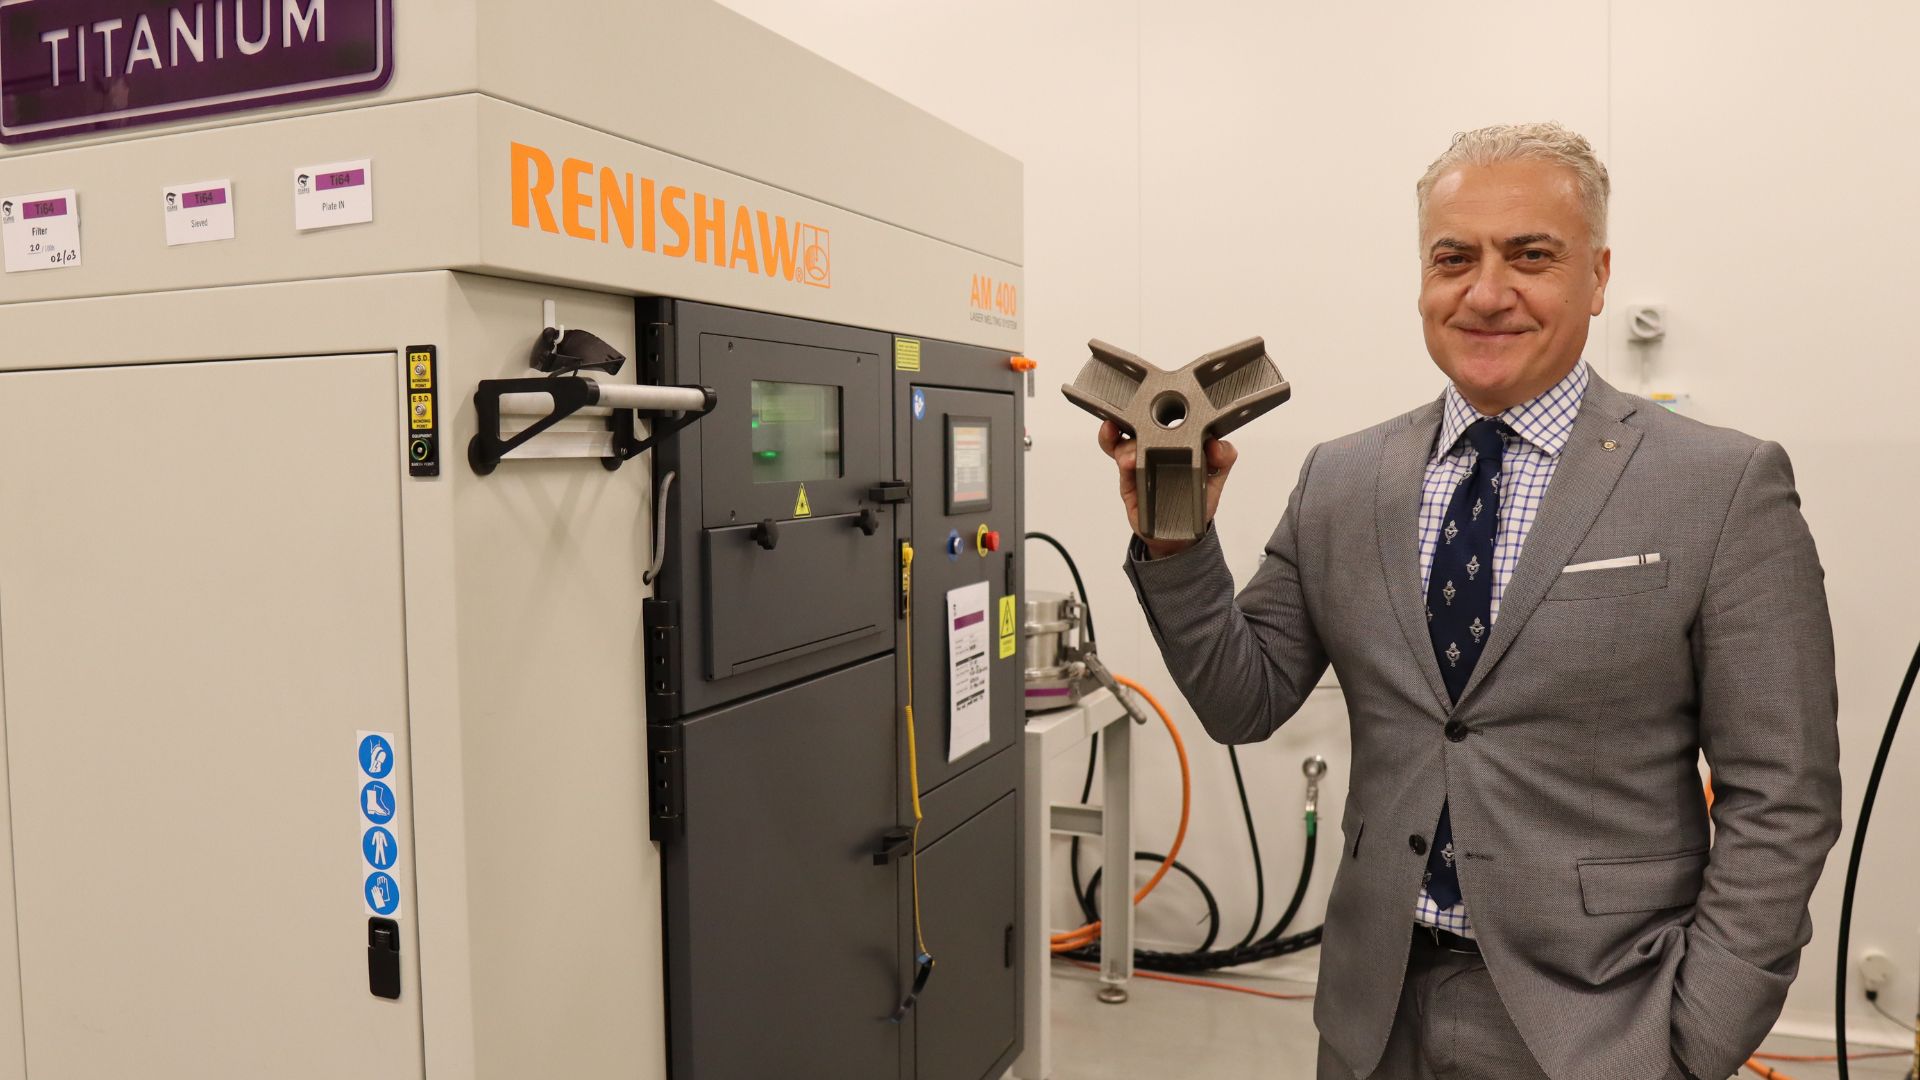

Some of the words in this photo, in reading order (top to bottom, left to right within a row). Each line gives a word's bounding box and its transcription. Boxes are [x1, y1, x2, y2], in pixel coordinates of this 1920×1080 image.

[40, 0, 326, 87] TITANIUM
[330, 174, 350, 186] Ti64
[194, 192, 213, 204] Ti64
[35, 202, 54, 215] Ti64
[322, 202, 337, 211] Plate
[338, 200, 345, 209] IN
[510, 141, 800, 282] RENISHAW
[191, 218, 208, 228] Sieved
[31, 227, 48, 236] Filter
[50, 249, 77, 264] 02/03
[970, 273, 992, 310] AM
[995, 281, 1016, 316] 400
